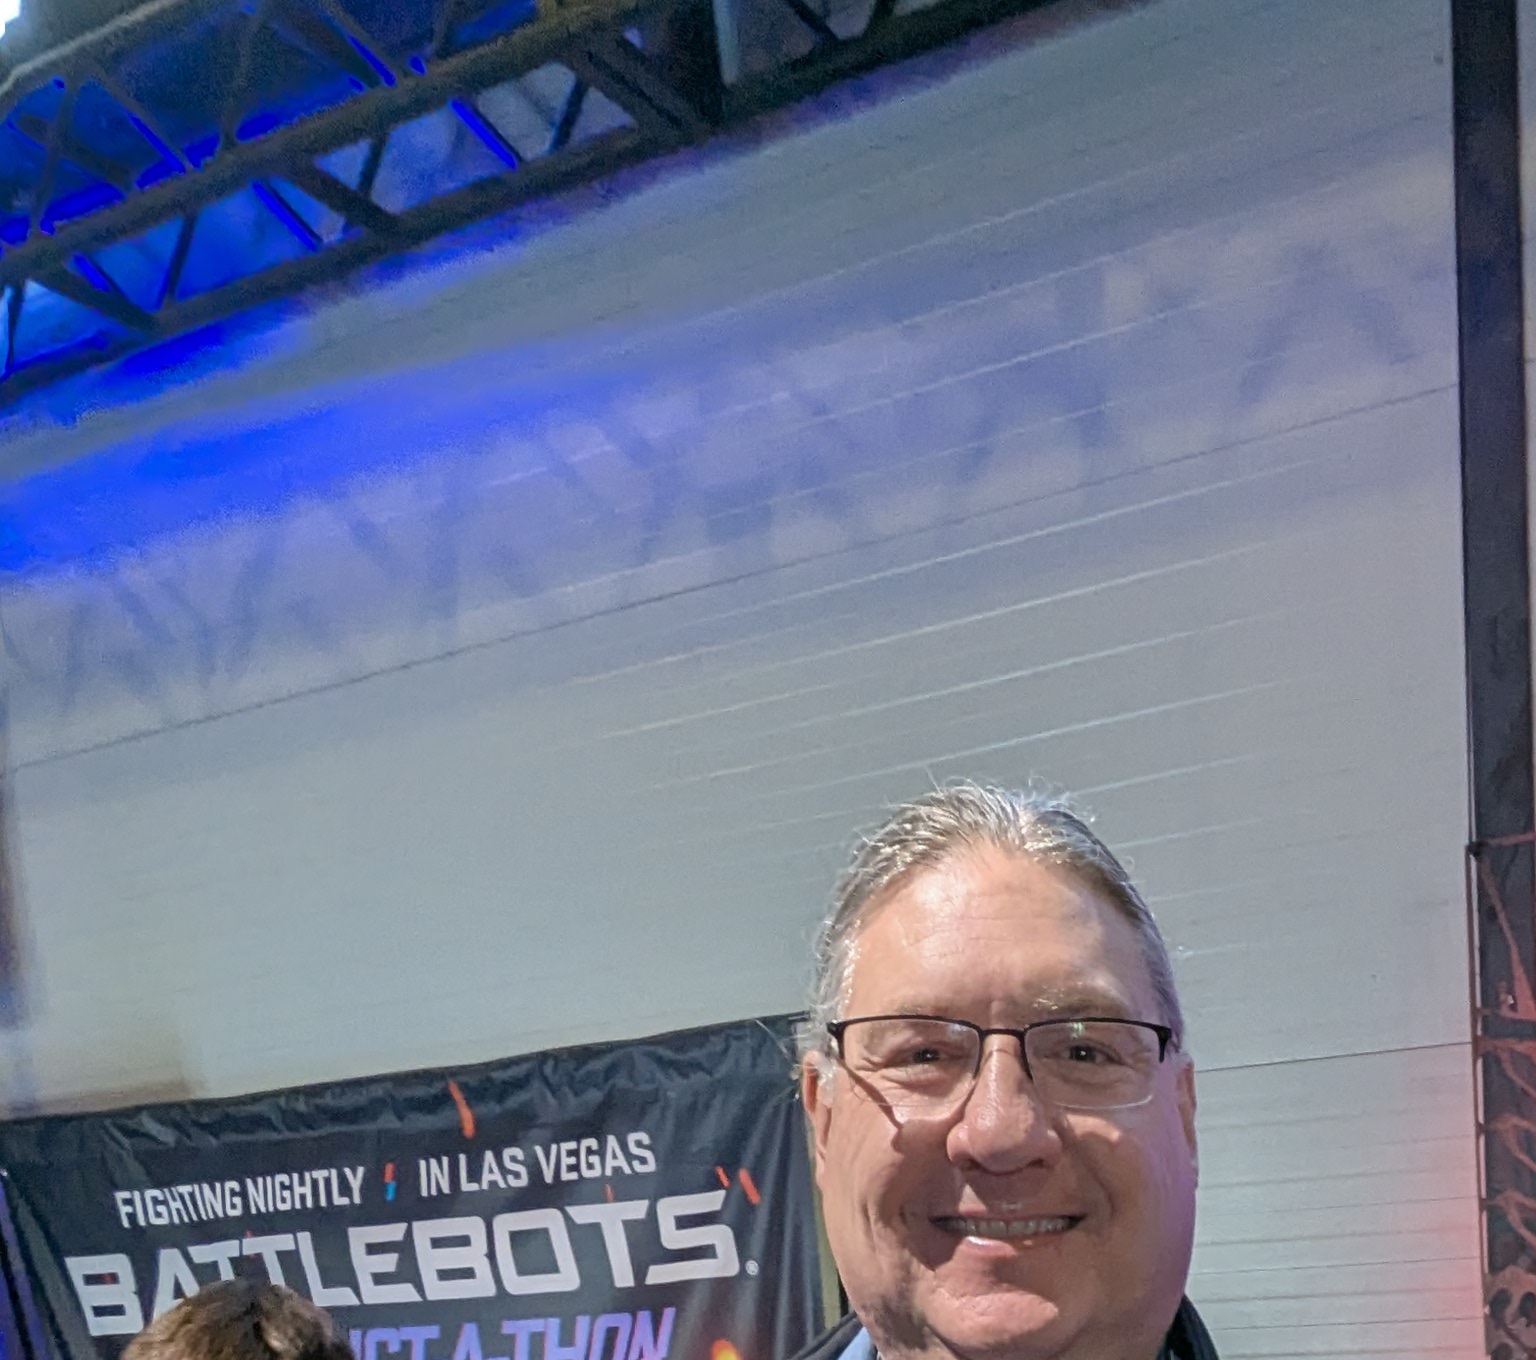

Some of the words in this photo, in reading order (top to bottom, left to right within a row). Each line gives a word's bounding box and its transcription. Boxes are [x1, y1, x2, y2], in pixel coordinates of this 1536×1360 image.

[418, 1154, 452, 1197] IN
[458, 1146, 528, 1193] LAS
[535, 1131, 656, 1184] VEGAS
[114, 1180, 243, 1229] FIGHTING
[244, 1166, 366, 1215] NIGHTLY
